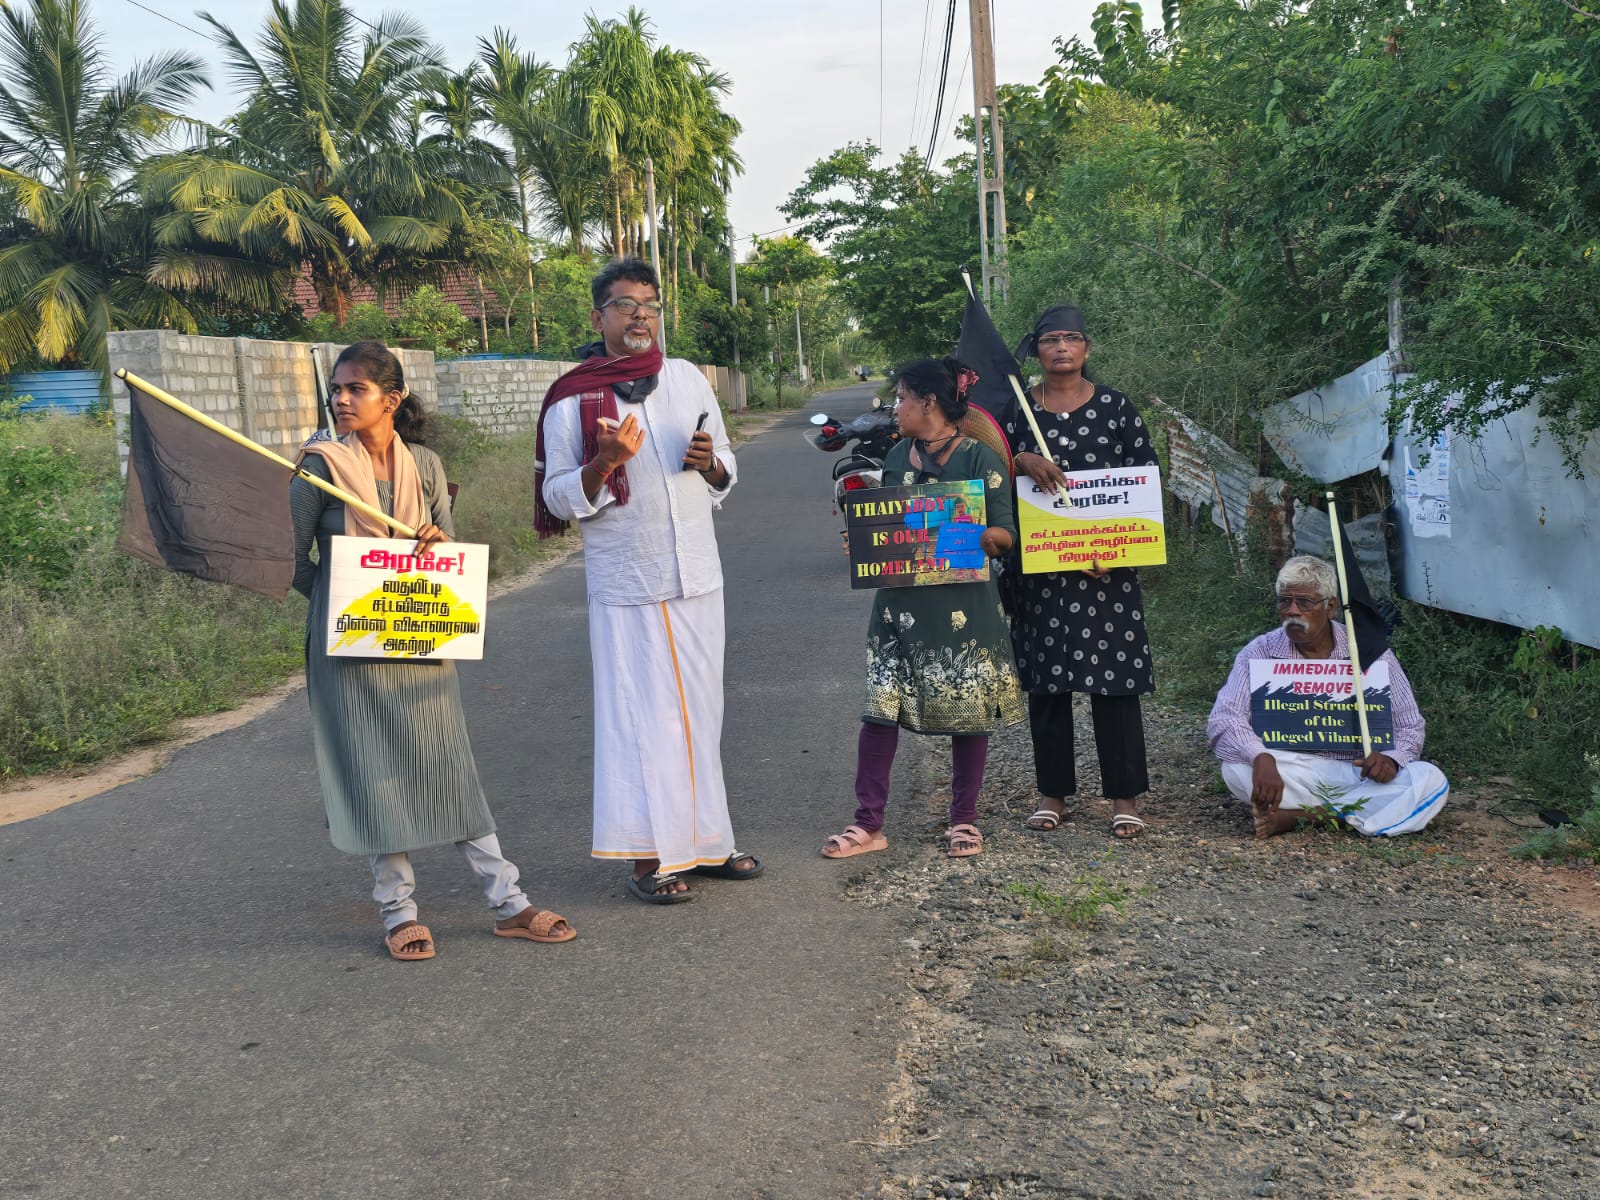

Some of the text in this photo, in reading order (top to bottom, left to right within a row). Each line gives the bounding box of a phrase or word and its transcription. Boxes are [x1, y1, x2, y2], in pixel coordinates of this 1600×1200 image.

[853, 496, 946, 517] THAIYIDDY
[1053, 491, 1129, 508] அரசே!
[872, 531, 888, 546] IS
[893, 528, 930, 545] OUR
[1031, 523, 1151, 539] கட்டமைக்கப்பட்ட
[1025, 535, 1158, 553] தமிழின அழிப்பை
[361, 549, 465, 575] அரசே!
[856, 557, 950, 577] HOMELAND
[382, 578, 442, 598] தையிட்டி
[372, 597, 450, 616] சட்டவிரோத
[393, 616, 480, 636] விகாரையை
[383, 636, 436, 656] அகற்று!
[1273, 663, 1370, 676] IMMEDIATE
[1293, 681, 1353, 694] REMOVE
[1264, 699, 1310, 713] Illegal
[1304, 715, 1345, 727] of the
[1262, 731, 1313, 745] Alleged
